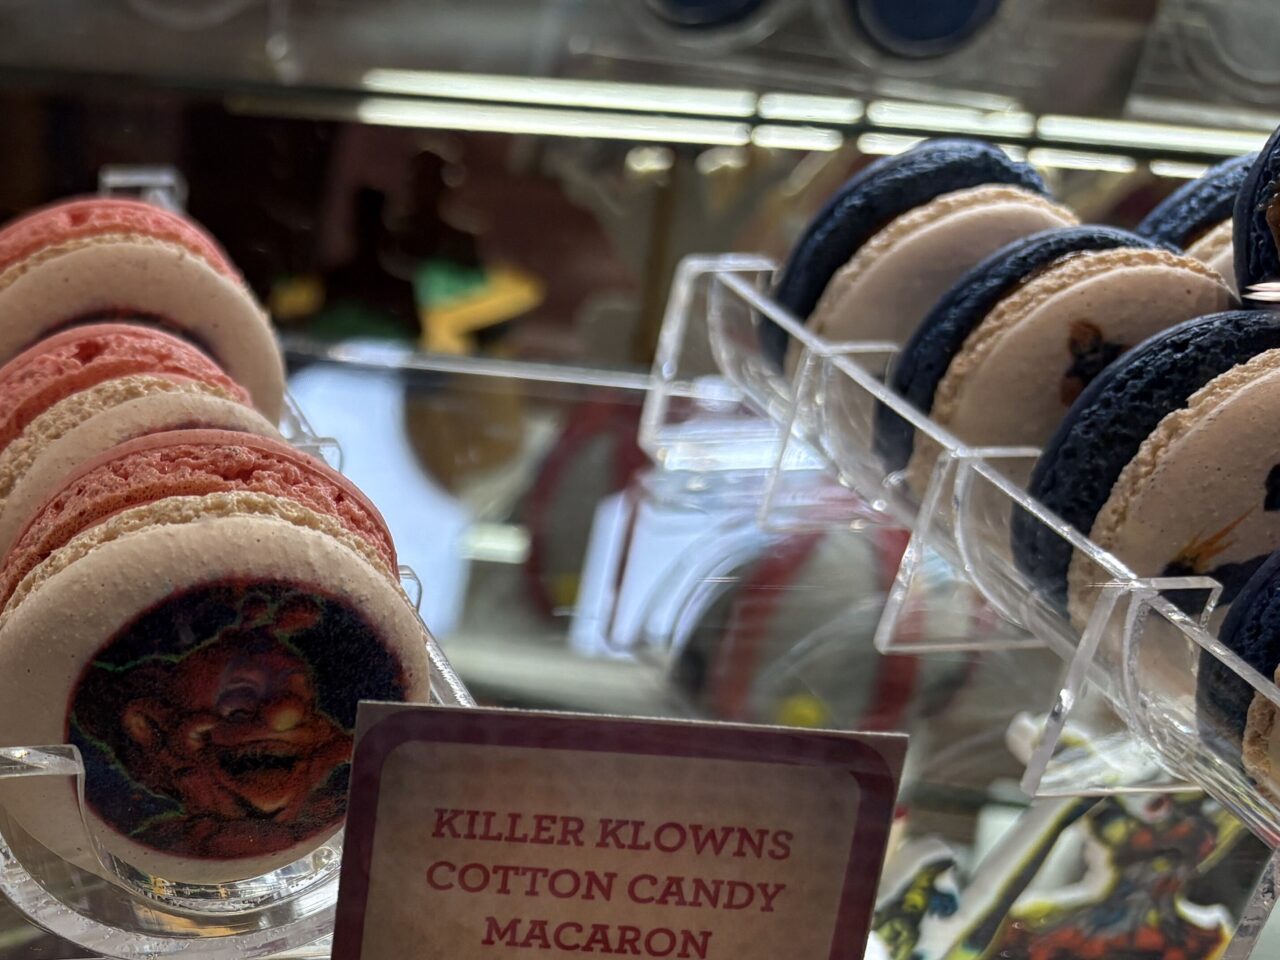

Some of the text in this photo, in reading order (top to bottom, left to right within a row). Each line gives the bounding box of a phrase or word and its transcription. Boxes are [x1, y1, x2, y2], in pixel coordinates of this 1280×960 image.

[431, 807, 794, 860] KILLER KLOWNS
[426, 860, 785, 912] COTTON CANDY
[481, 916, 712, 960] MACARON
